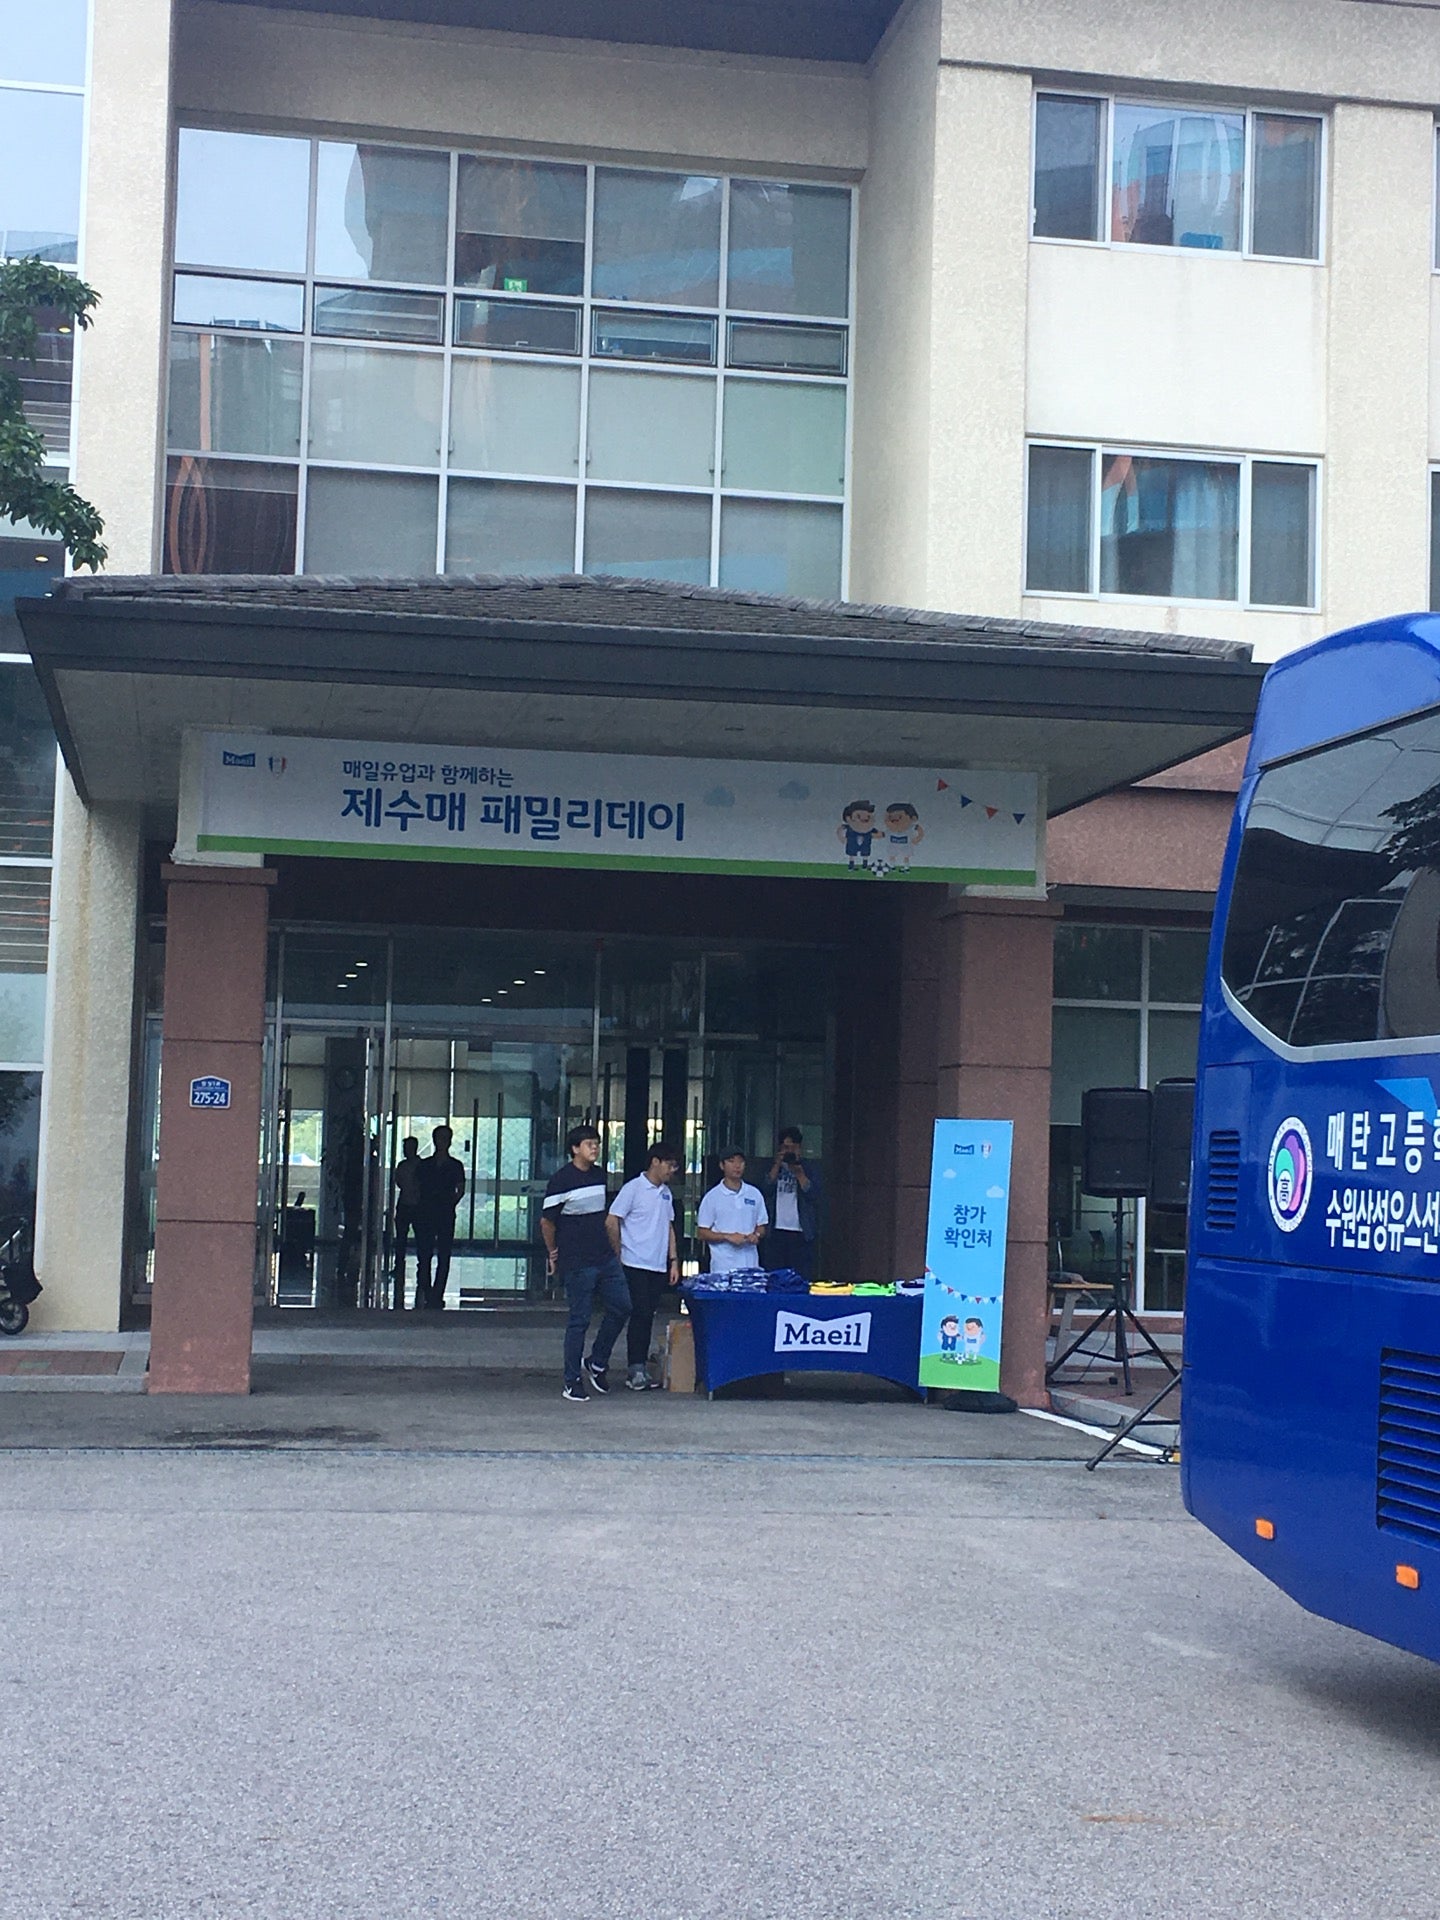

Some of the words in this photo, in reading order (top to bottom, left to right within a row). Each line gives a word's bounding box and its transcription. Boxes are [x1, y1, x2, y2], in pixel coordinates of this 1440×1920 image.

[342, 760, 436, 783] 매일유업과
[441, 764, 514, 788] 함께하는
[341, 787, 466, 832] 제수매
[480, 795, 685, 841] 패밀리데이
[193, 1091, 226, 1104] 275-24
[953, 1204, 987, 1225] 참가
[943, 1226, 992, 1248] 확인처
[782, 1322, 863, 1346] Maeil
